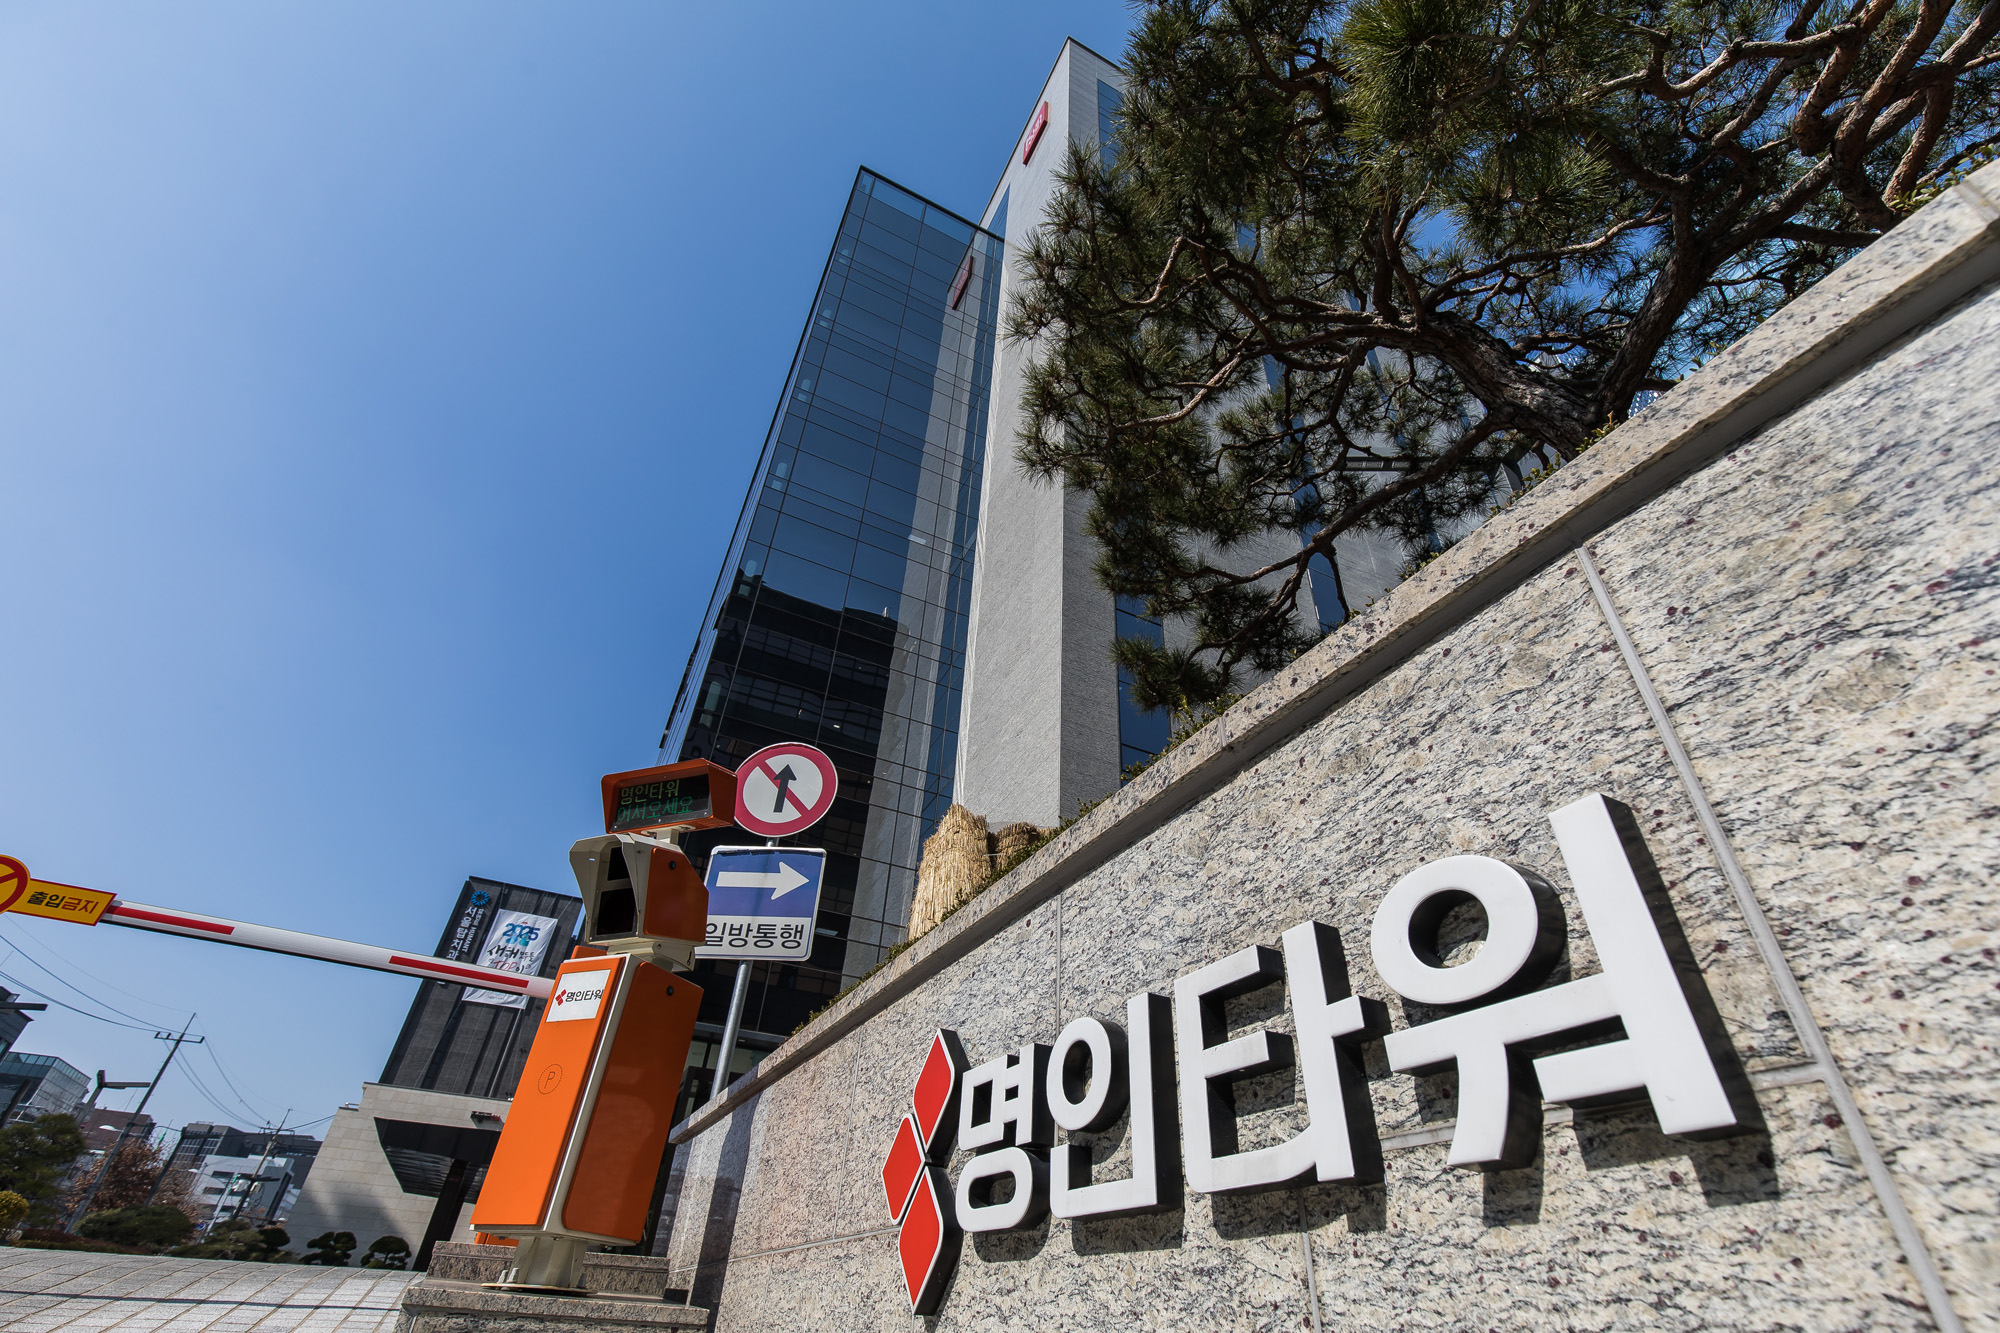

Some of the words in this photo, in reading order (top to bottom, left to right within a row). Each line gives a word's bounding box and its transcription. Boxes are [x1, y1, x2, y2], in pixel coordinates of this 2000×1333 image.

[621, 780, 679, 805] 명인타워
[617, 797, 693, 821] 어서오세요
[27, 891, 99, 914] 출입금지
[502, 923, 541, 941] 2025
[705, 922, 804, 949] 일방통행
[487, 945, 519, 959] 새해
[565, 989, 604, 1002] 명인타워
[955, 793, 1741, 1234] 명인타워
